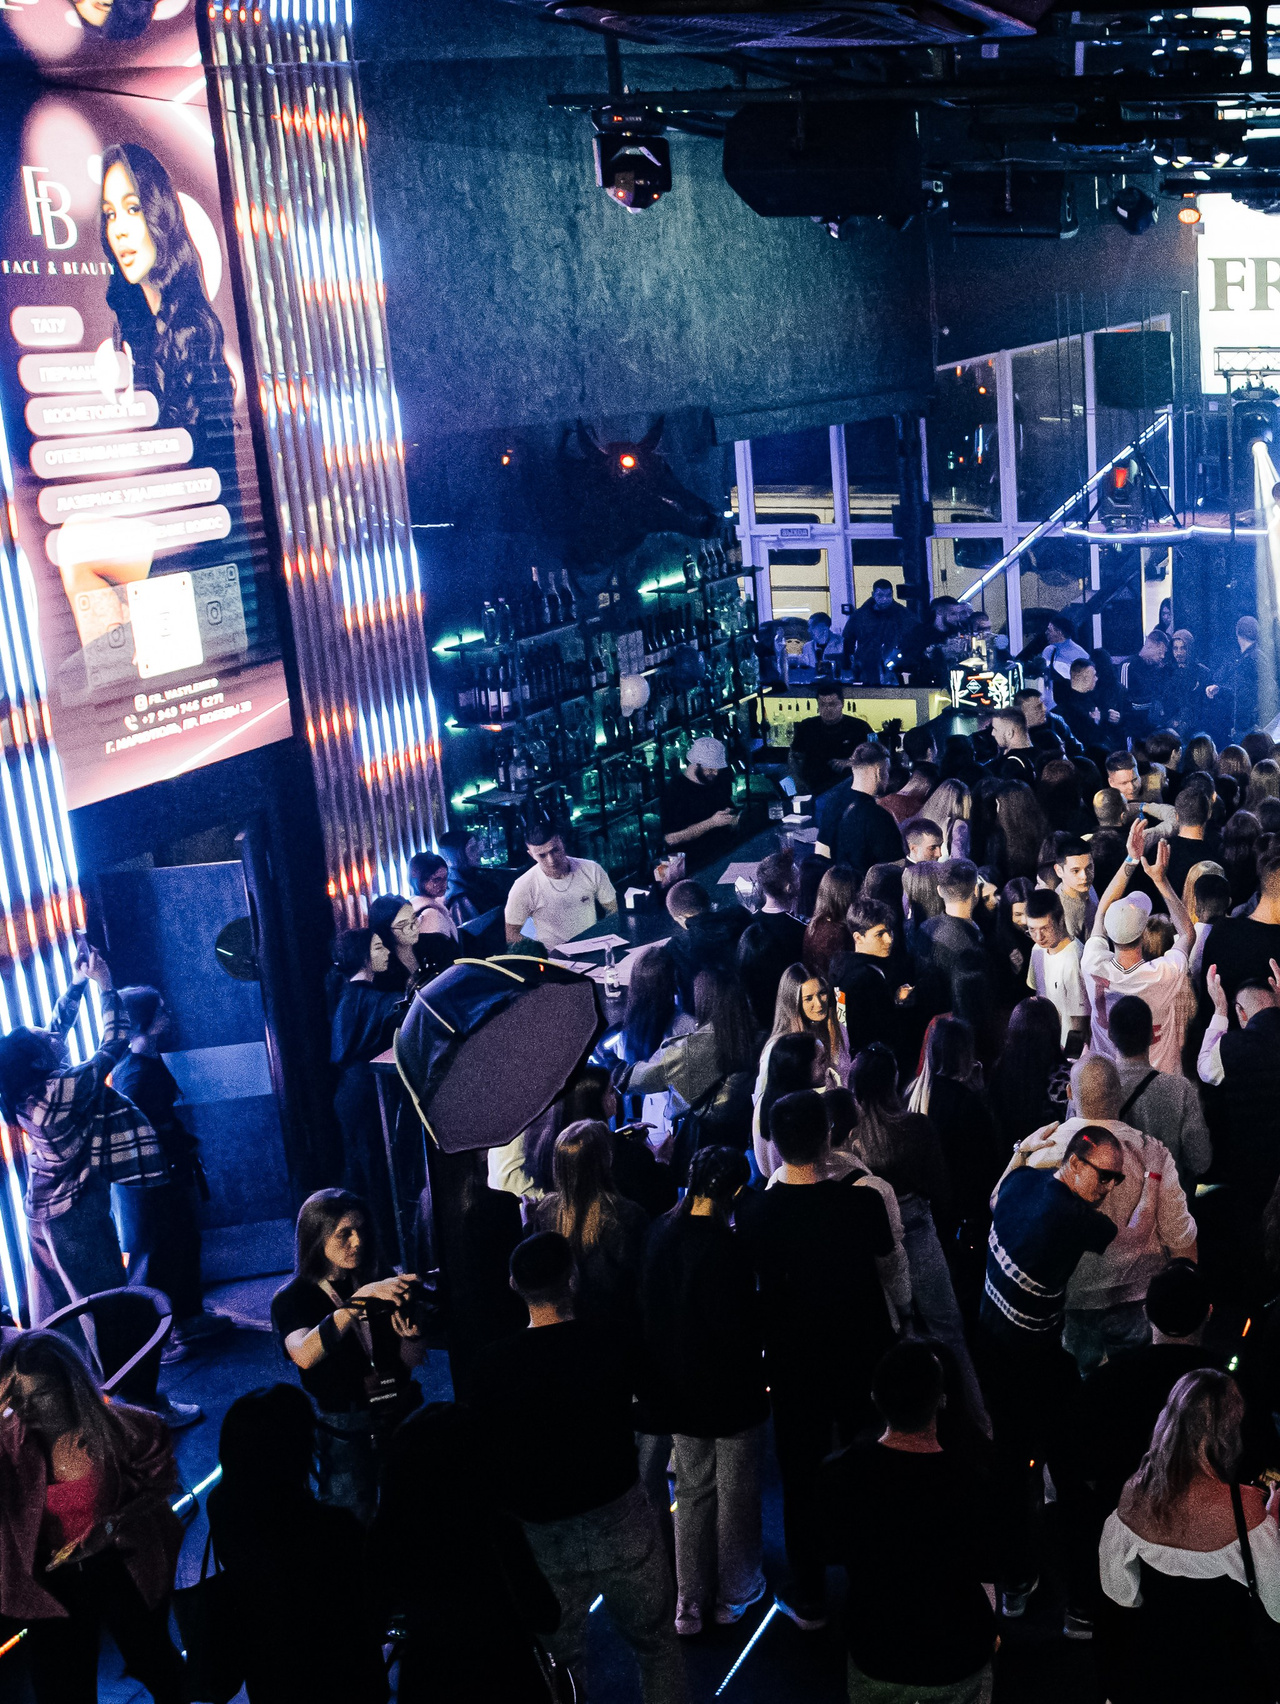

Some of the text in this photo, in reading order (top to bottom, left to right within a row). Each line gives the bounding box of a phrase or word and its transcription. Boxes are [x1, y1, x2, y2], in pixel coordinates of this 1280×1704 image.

[22, 165, 79, 250] FB
[2, 259, 115, 276] FACE & BEAUTY
[30, 318, 67, 334] ТАТУ
[39, 365, 97, 383] ПЕРМАН
[42, 401, 147, 424] КОСМЕТОЛОГИЯ
[45, 439, 181, 465] ОТБЕЛИВАНИЕ ЗУБОВ
[57, 478, 213, 512] ЛАЗЕРНОЕ УДАЛЕНИЕ ТАТУ
[186, 516, 225, 534] ВОЛОС
